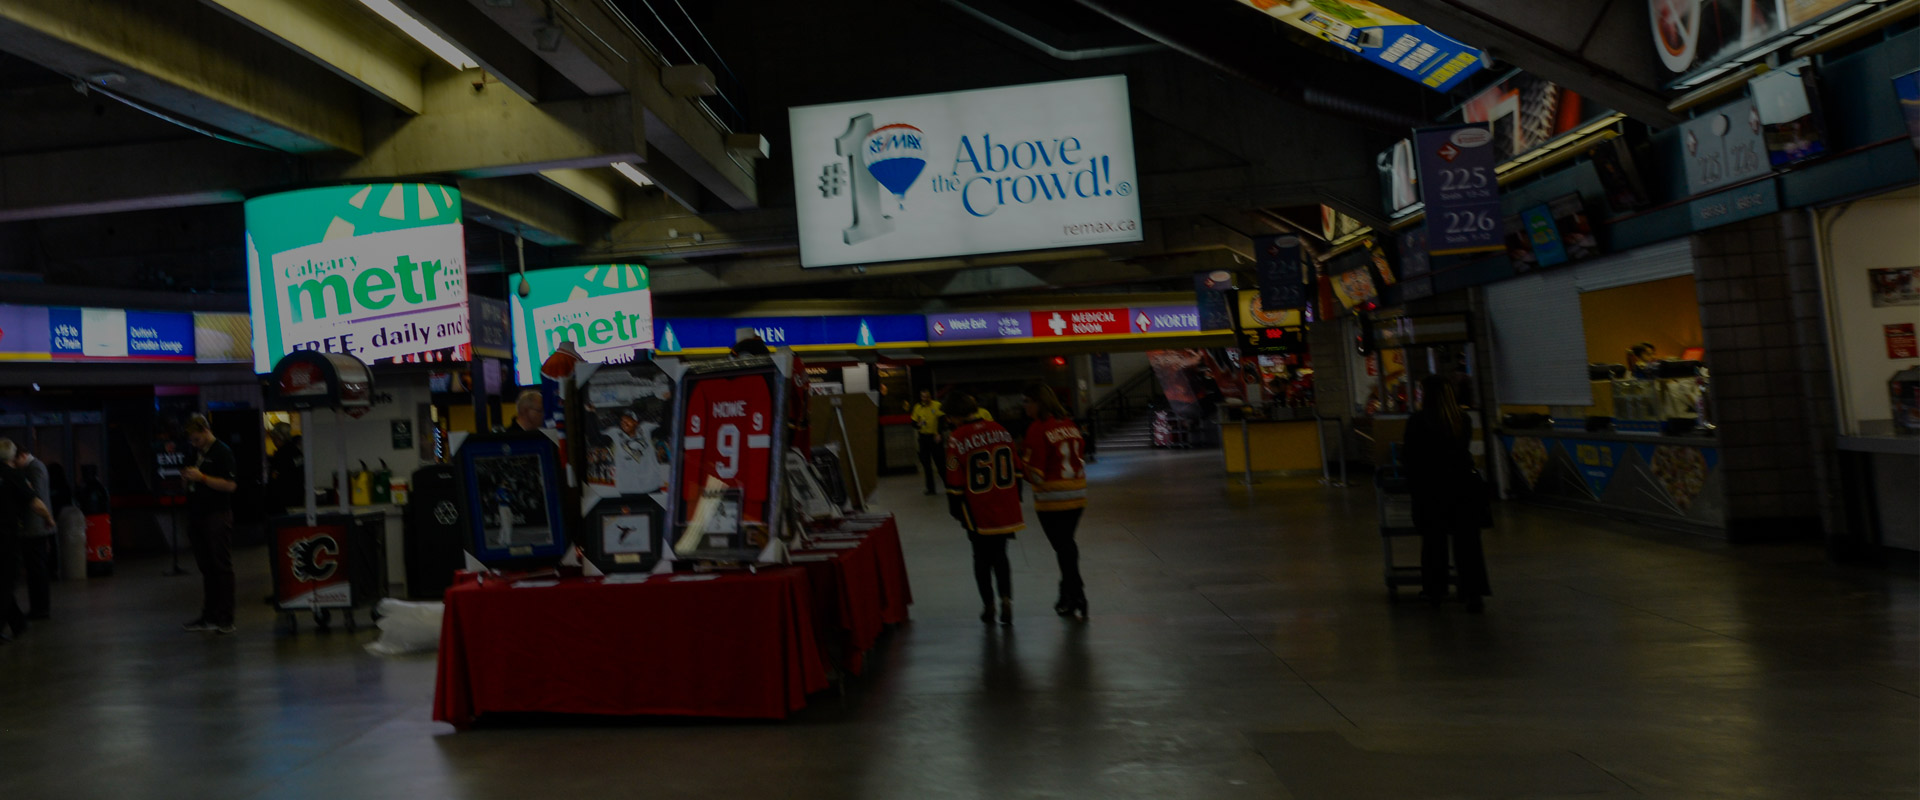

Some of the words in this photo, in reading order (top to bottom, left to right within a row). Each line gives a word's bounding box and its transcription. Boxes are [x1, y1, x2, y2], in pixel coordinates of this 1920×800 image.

[953, 132, 1081, 174] Above
[931, 174, 961, 193] the
[1439, 167, 1488, 191] 225
[1063, 218, 1137, 236] remax.ca
[1445, 209, 1496, 234] 226
[948, 318, 971, 330] West
[970, 317, 988, 329] Exit
[1070, 311, 1117, 323] MEDICAL
[1153, 313, 1199, 329] NORTH
[371, 322, 430, 345] daily
[1072, 322, 1104, 334] ROOM
[690, 413, 701, 434] 9
[752, 411, 764, 431] 9
[156, 451, 185, 465] EXIT
[714, 422, 741, 479] 9
[965, 444, 1015, 495] 60
